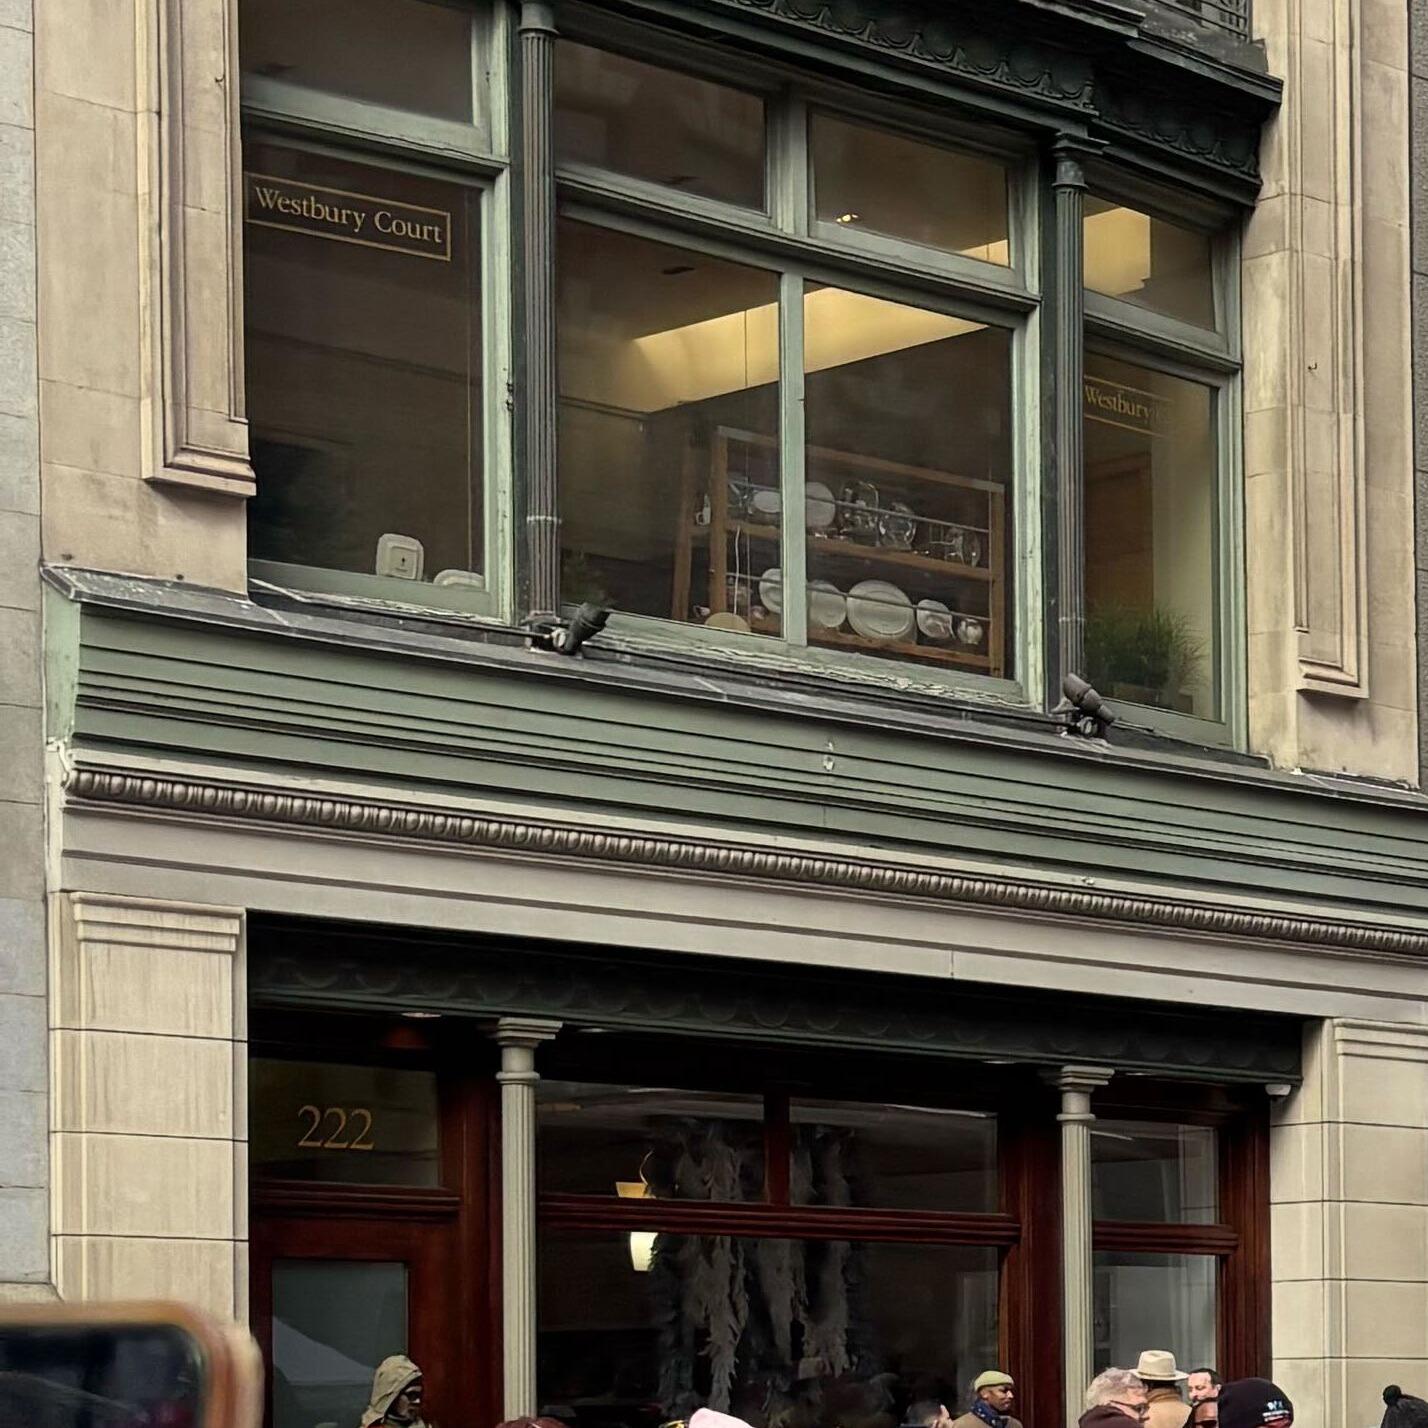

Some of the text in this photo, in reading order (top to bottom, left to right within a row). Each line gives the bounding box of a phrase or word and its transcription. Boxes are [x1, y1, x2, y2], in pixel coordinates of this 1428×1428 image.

[255, 186, 443, 243] Westbury Court
[1084, 385, 1150, 424] Westbury
[298, 1105, 375, 1150] 222
